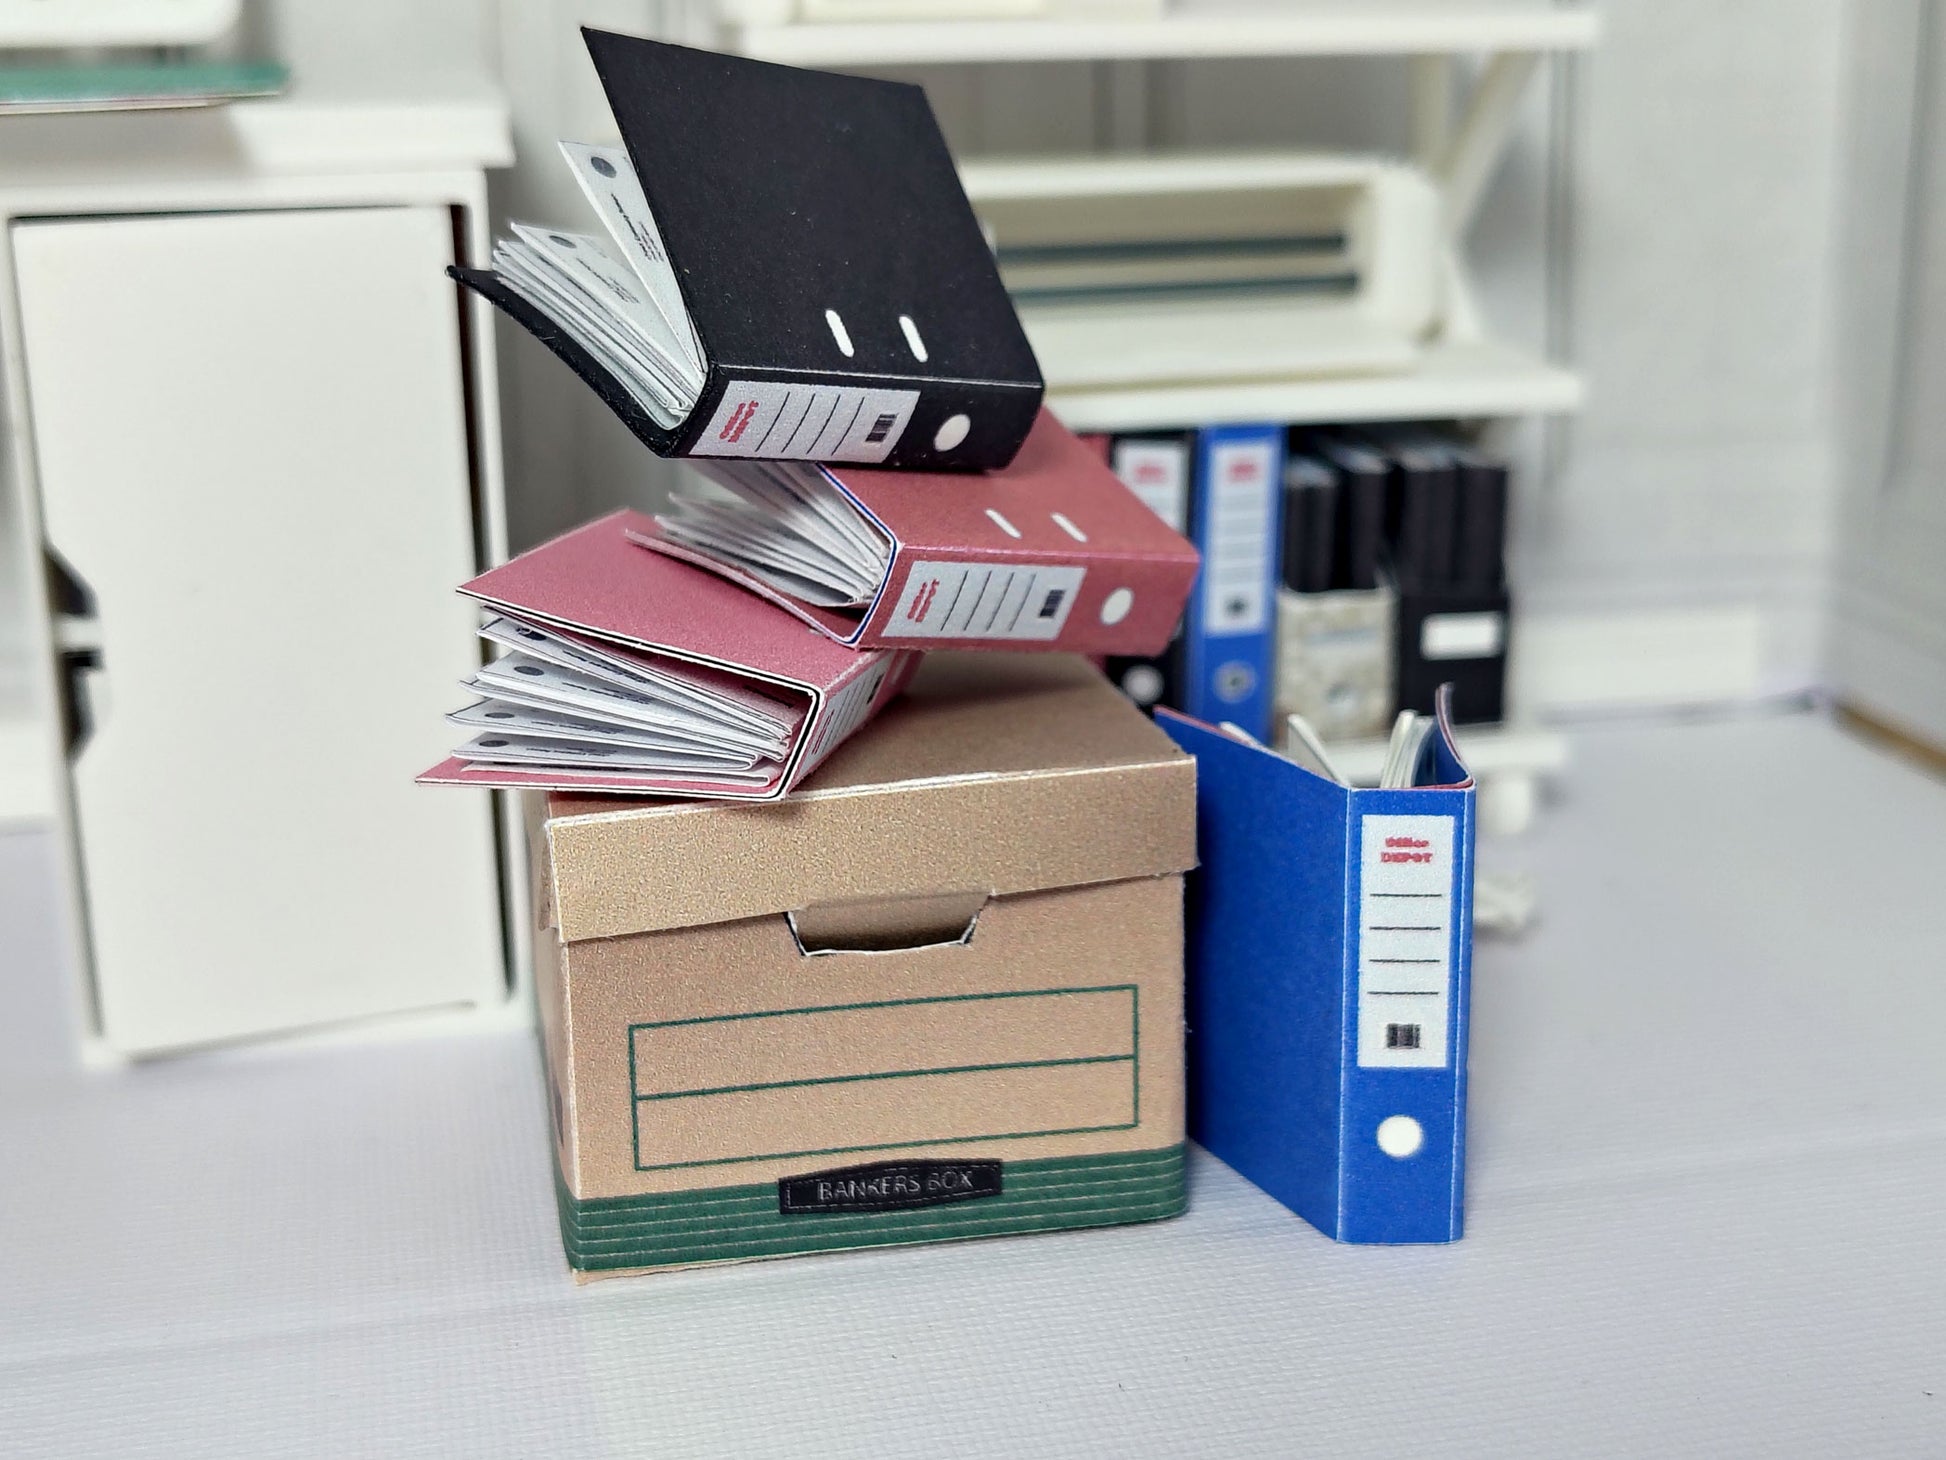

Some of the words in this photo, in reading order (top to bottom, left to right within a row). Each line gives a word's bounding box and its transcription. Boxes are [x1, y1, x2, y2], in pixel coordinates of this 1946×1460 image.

[1380, 851, 1433, 863] DEPOT
[818, 1175, 921, 1201] BANKERS
[928, 1170, 973, 1191] BOX
